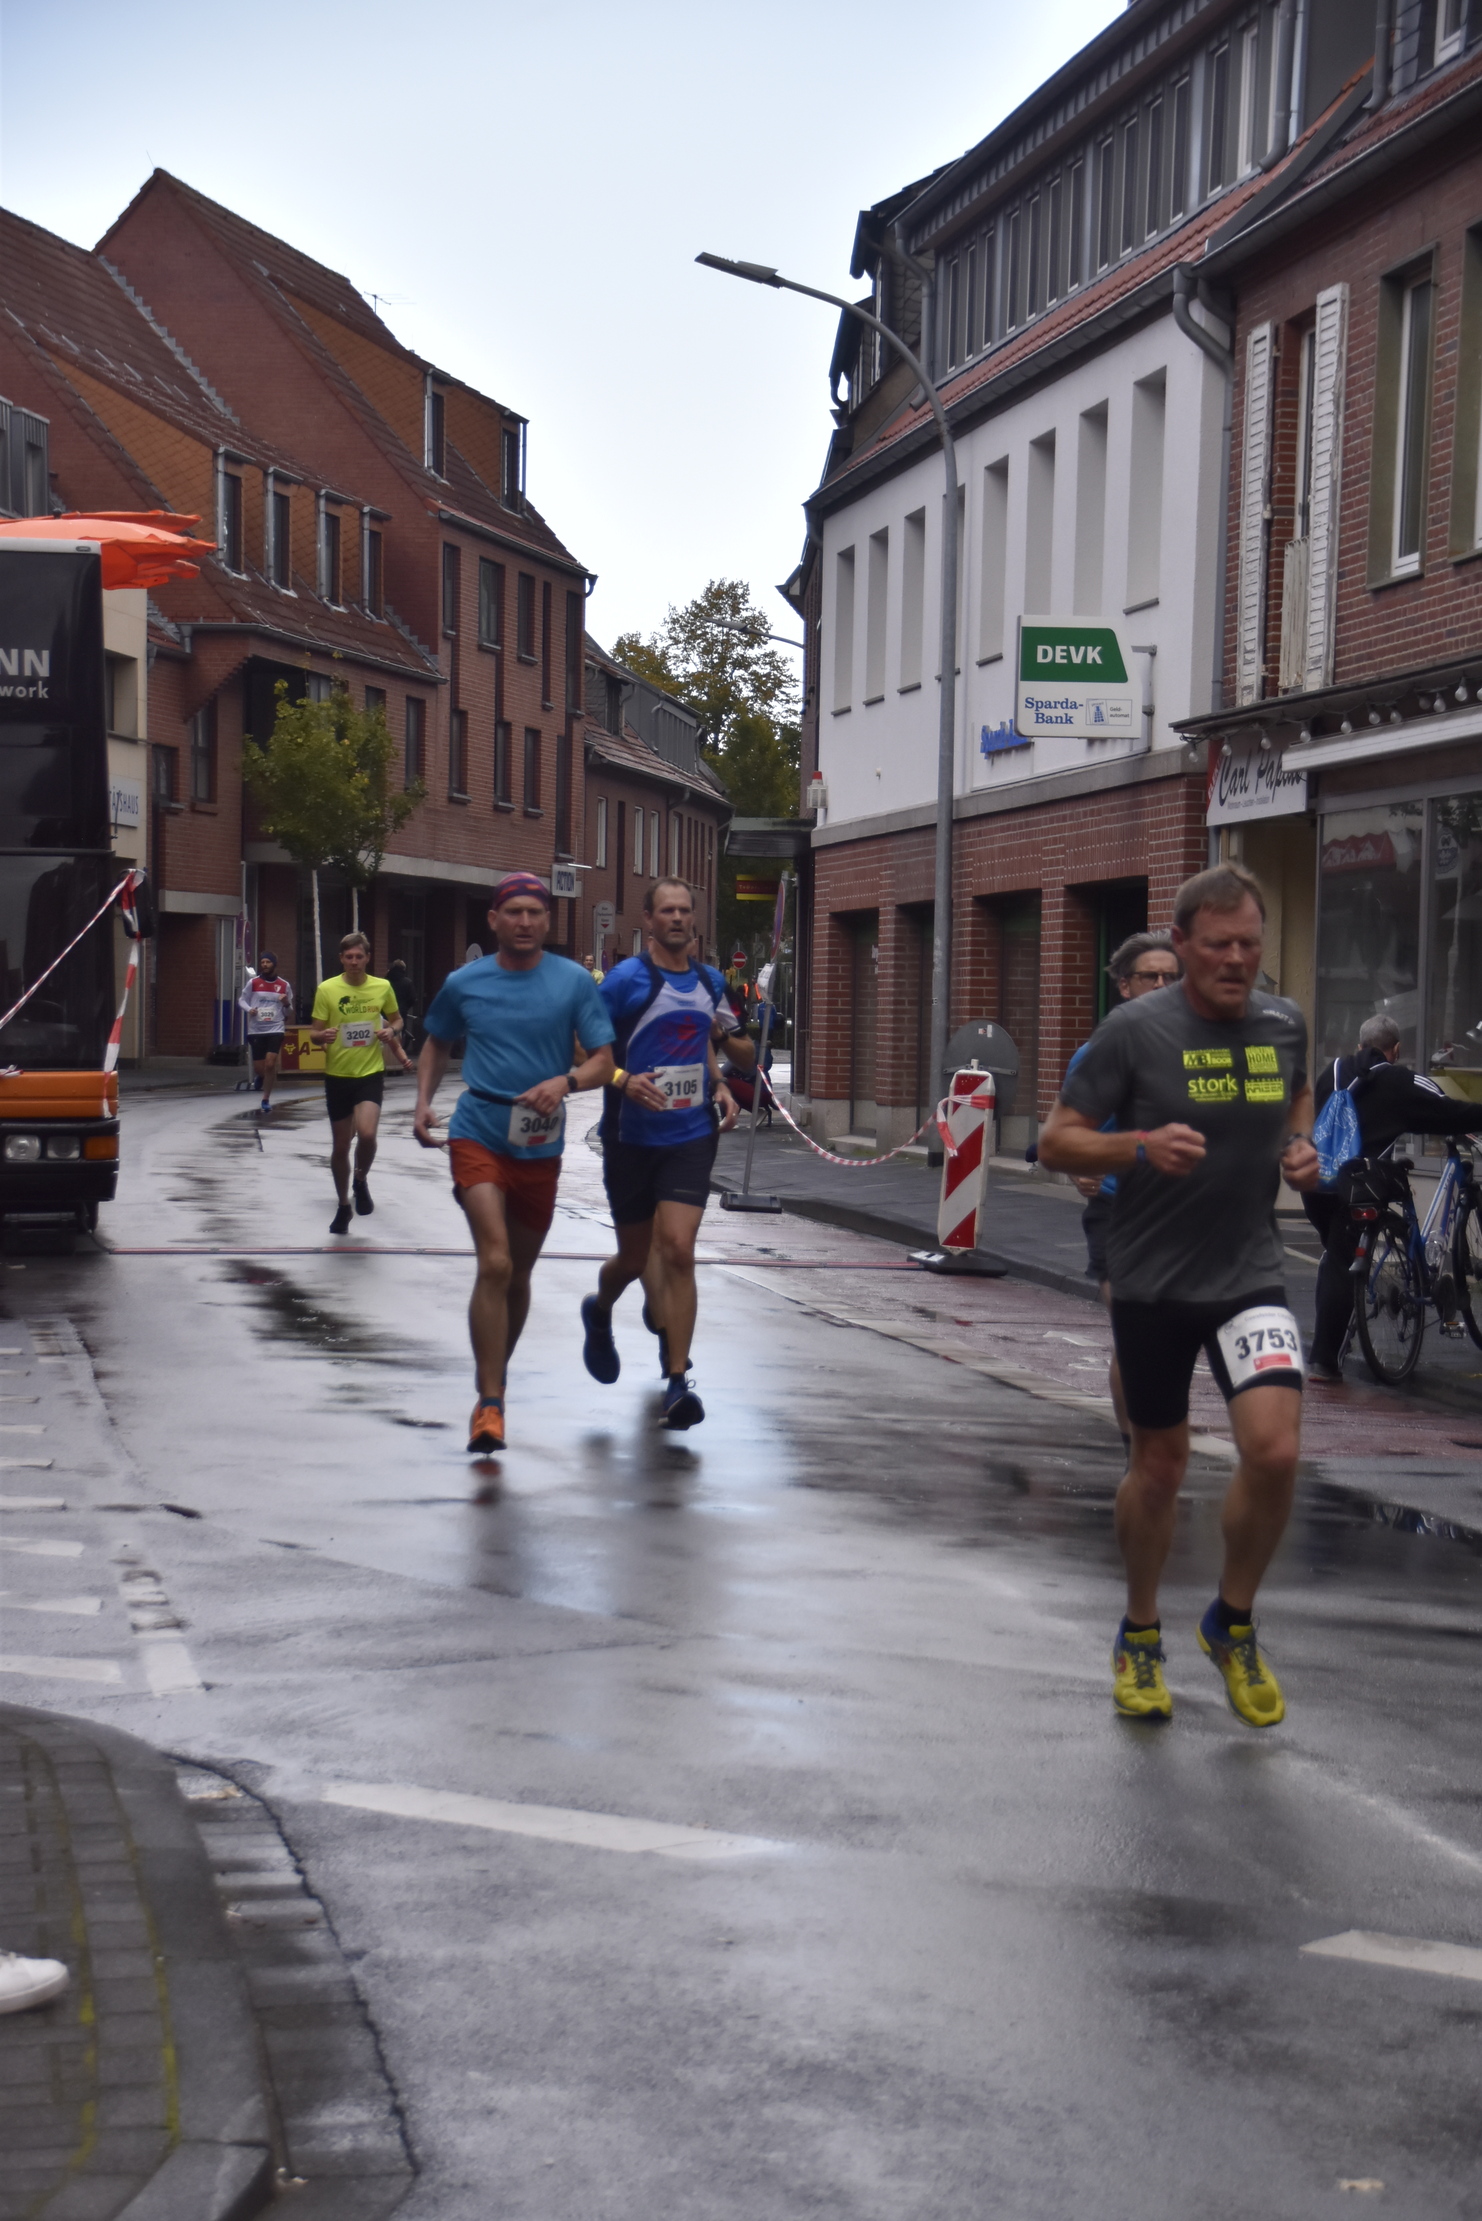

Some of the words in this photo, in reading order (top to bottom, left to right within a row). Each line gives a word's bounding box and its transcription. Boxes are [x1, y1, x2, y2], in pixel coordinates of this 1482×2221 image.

[1036, 645, 1103, 665] DEVK
[1024, 696, 1084, 711] Sparda-
[1034, 713, 1074, 725] Bank
[346, 1029, 371, 1041] 3202
[1248, 1053, 1276, 1063] HOME
[664, 1079, 697, 1097] 3105
[1188, 1073, 1238, 1093] stork
[1234, 1328, 1298, 1360] 3753
